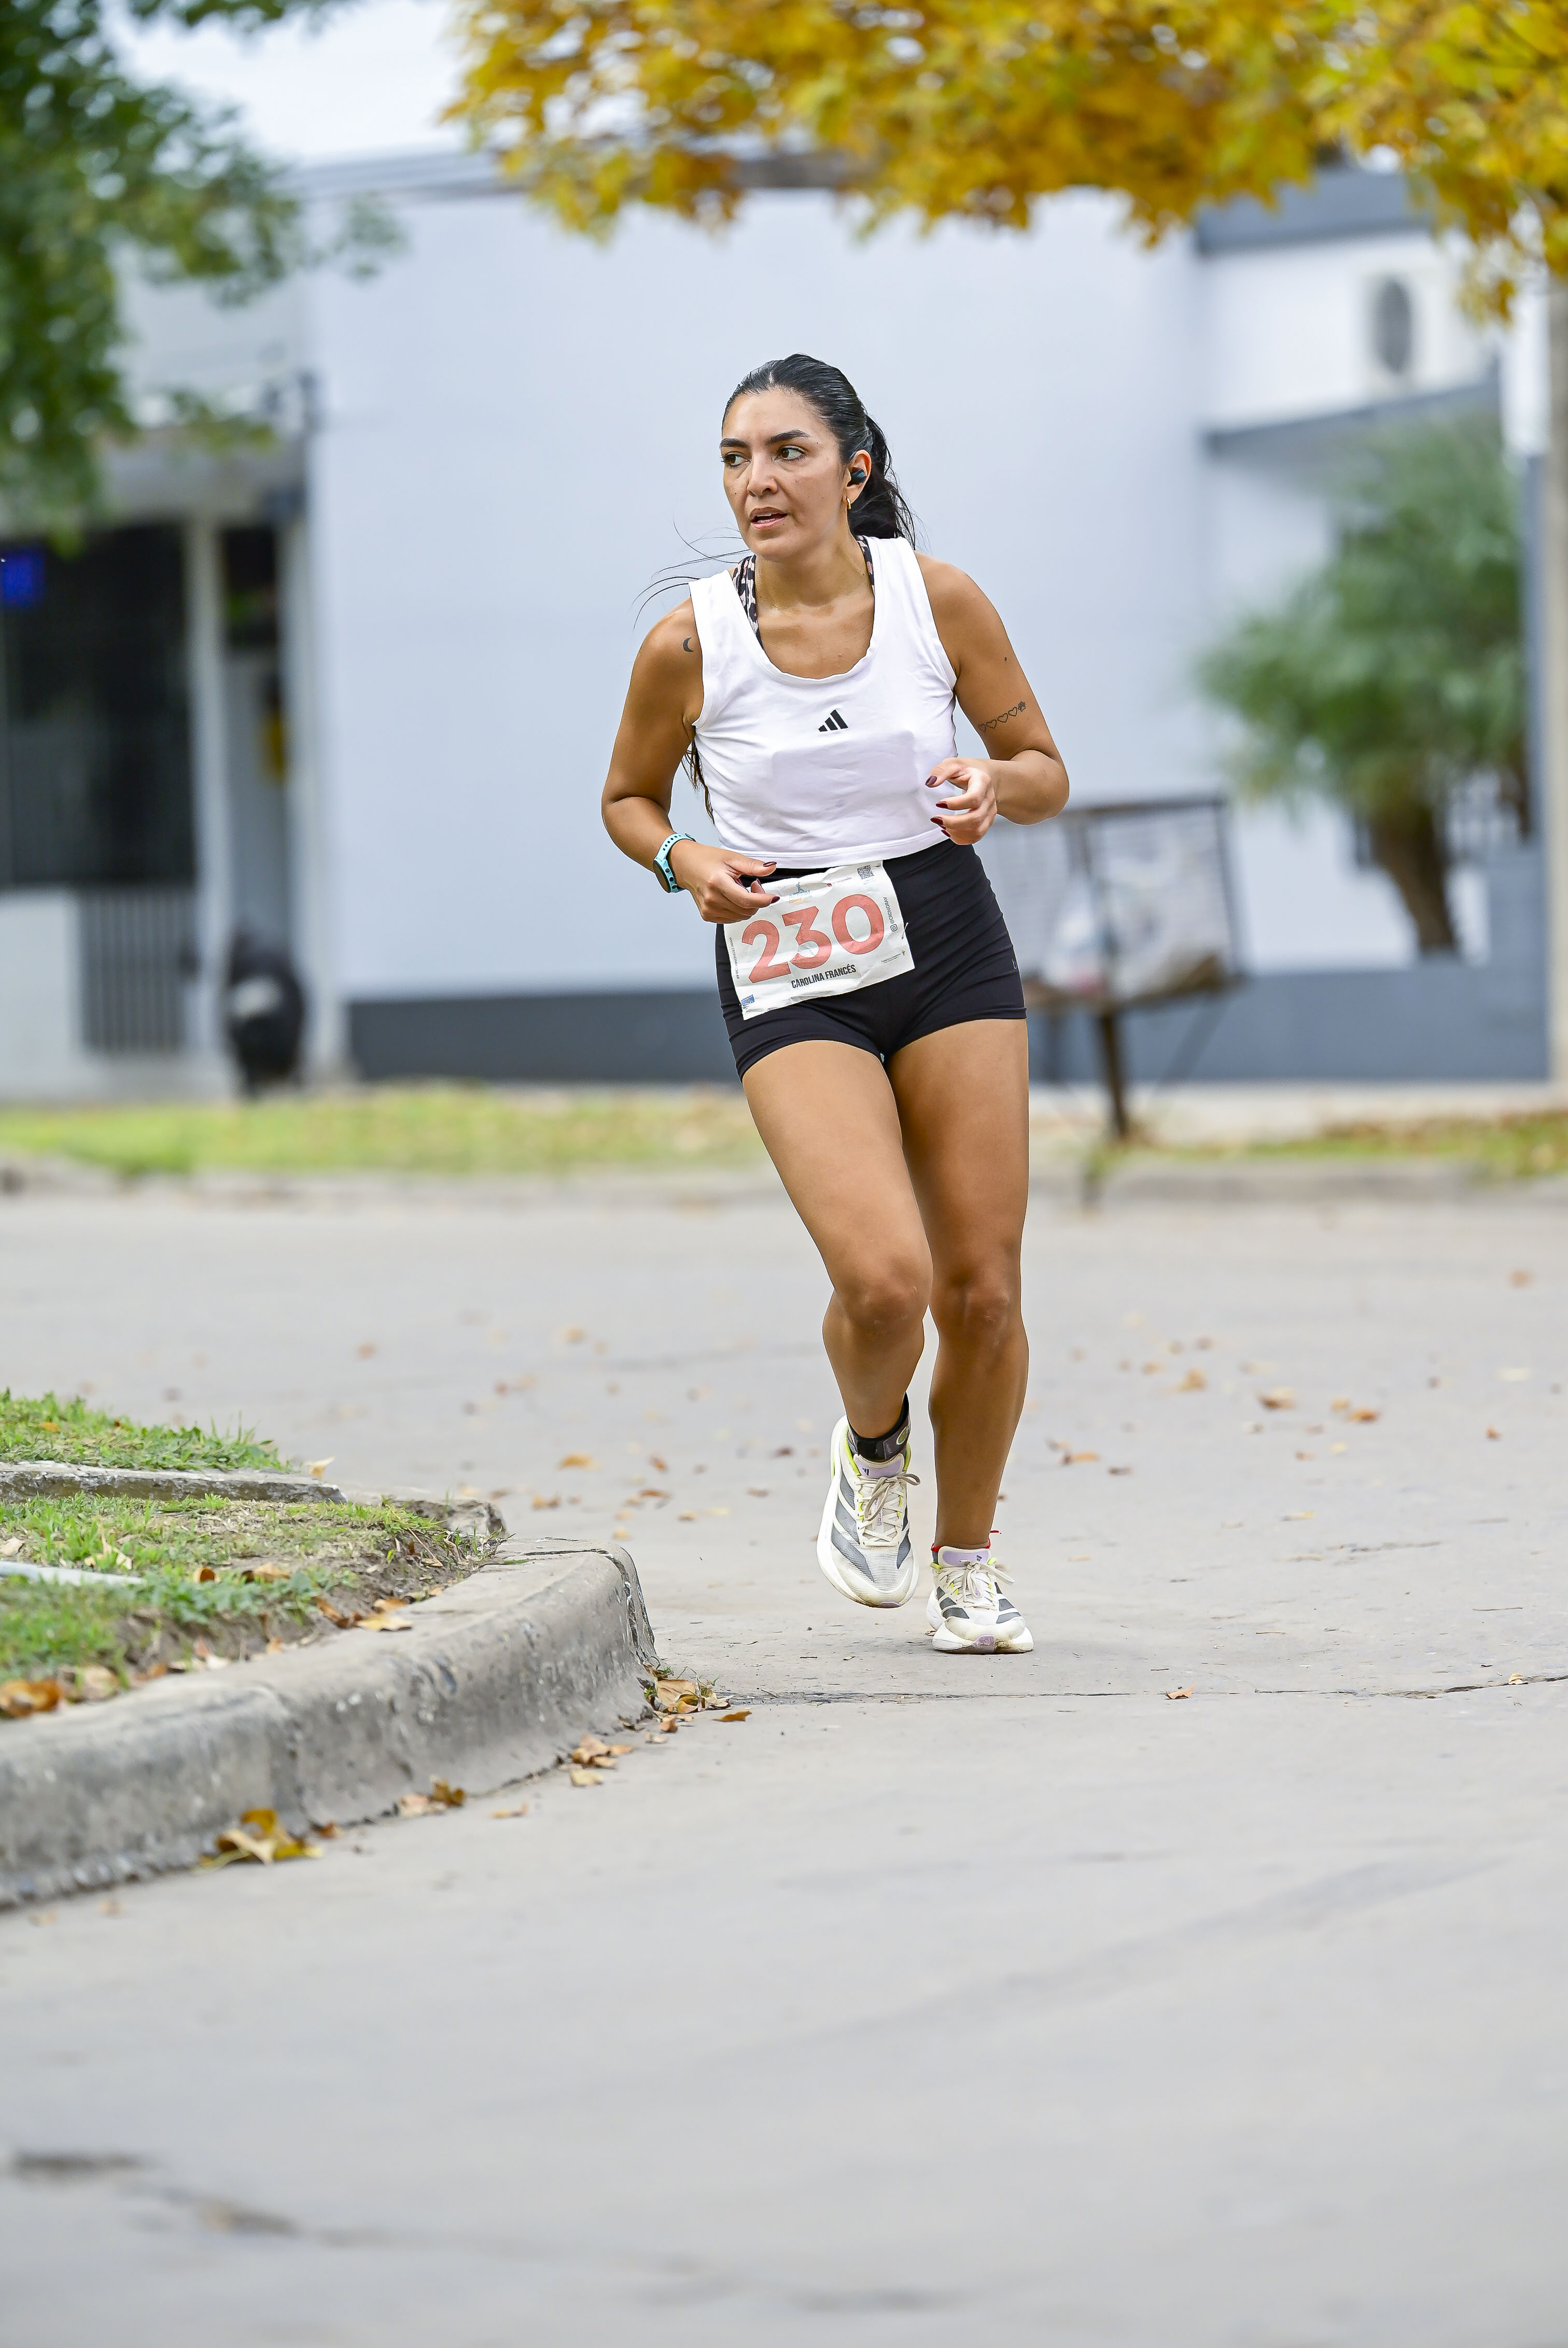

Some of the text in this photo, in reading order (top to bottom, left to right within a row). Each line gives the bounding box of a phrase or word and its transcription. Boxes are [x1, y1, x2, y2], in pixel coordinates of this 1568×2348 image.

[741, 894, 885, 984] 230
[791, 963, 857, 988] CAROLINA FRANCÉS
